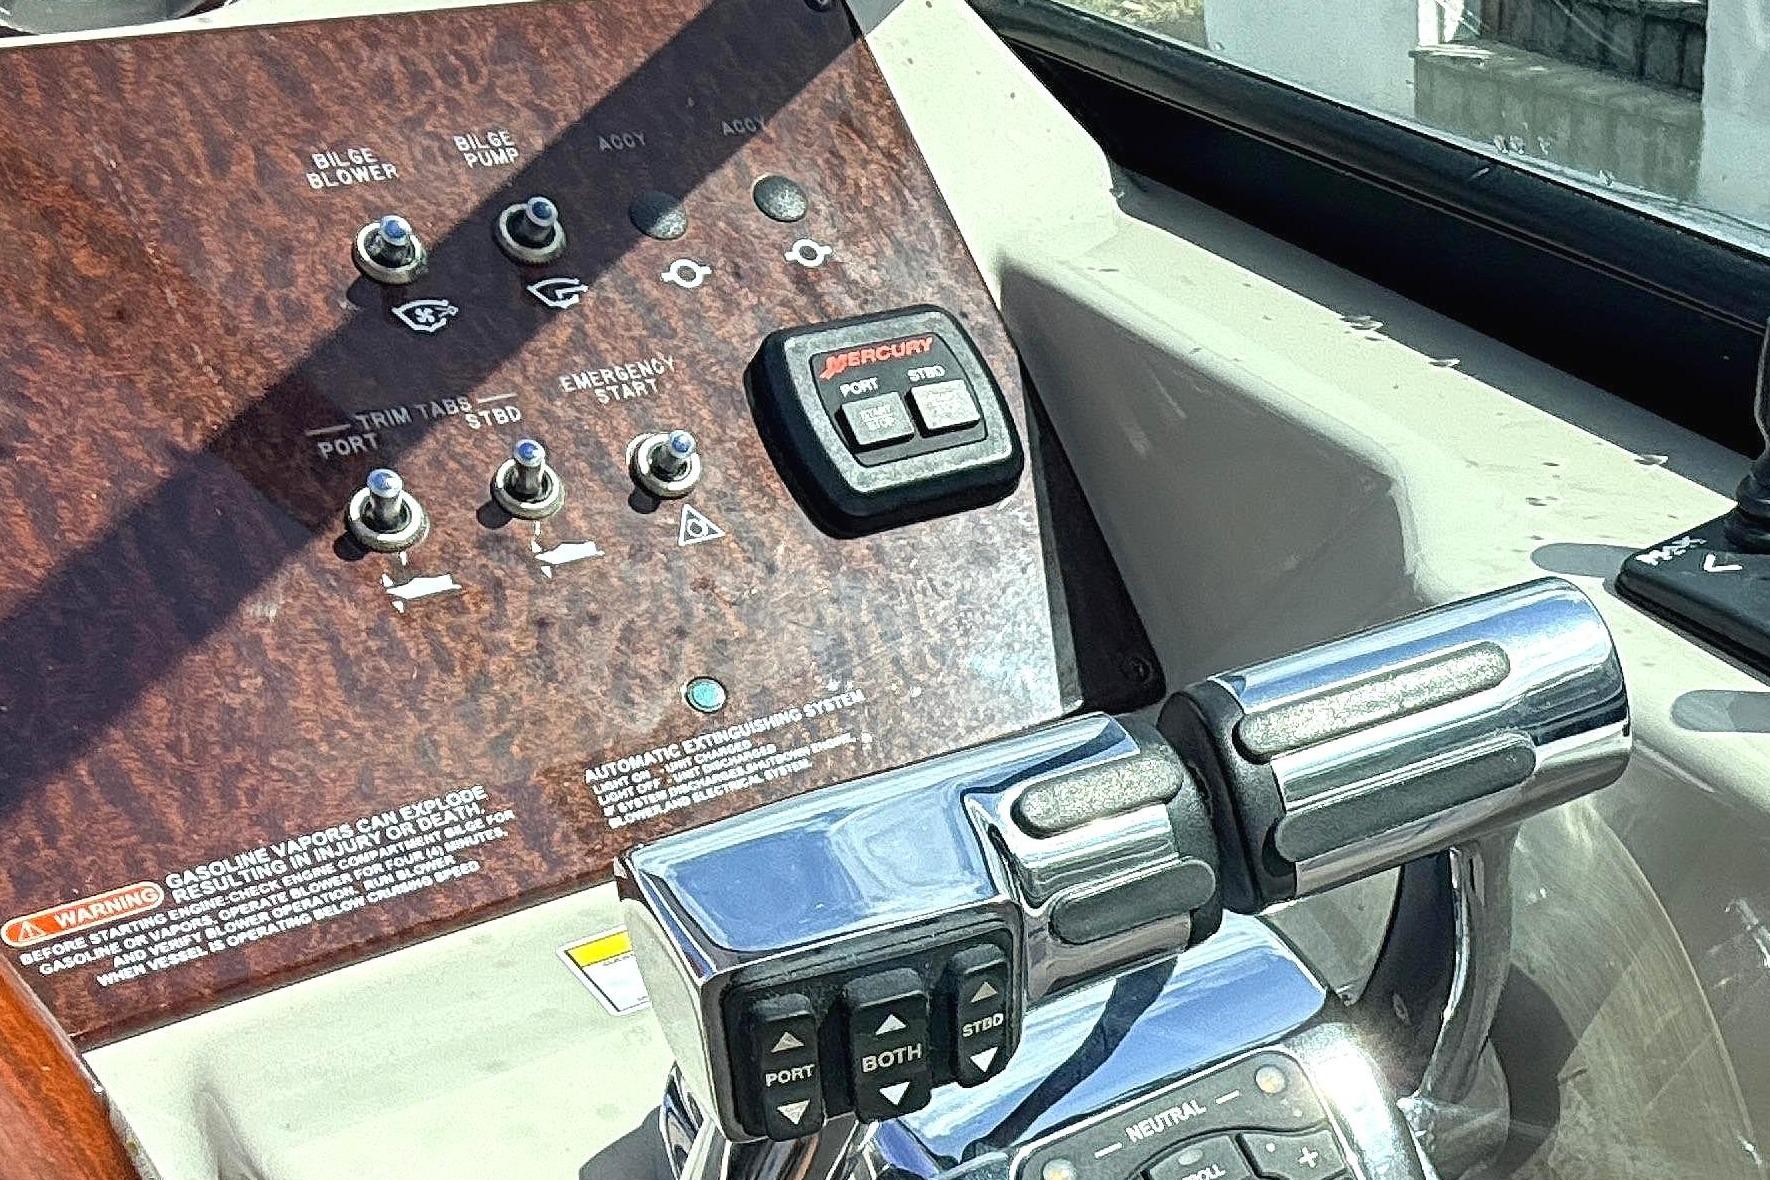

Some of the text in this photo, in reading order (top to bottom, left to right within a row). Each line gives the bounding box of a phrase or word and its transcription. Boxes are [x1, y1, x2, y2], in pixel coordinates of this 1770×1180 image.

[453, 128, 515, 151] BILGE
[312, 147, 378, 170] BILGE
[463, 148, 519, 169] PUMP
[306, 162, 399, 190] BLOWER
[559, 351, 677, 392] EMERGENCY
[820, 336, 933, 381] MERCURY
[593, 377, 658, 406] START
[839, 376, 878, 398] PORT
[355, 395, 473, 431] TRIM TABS
[462, 405, 522, 429] STBD
[317, 432, 378, 460] PORT
[585, 689, 867, 783] AUTOMATIC EXTINGUISHING SYSTEM
[165, 785, 489, 890] GASOLINE VAPORS CAN EXPLODE
[171, 802, 487, 904] RESULTING IN INJURY OR DEATH.
[53, 887, 157, 930] WARNING
[961, 1010, 1004, 1037] STBD
[860, 1040, 923, 1074] BOTH
[764, 1062, 816, 1087] PORT
[1126, 1098, 1208, 1145] NEUTRAL
